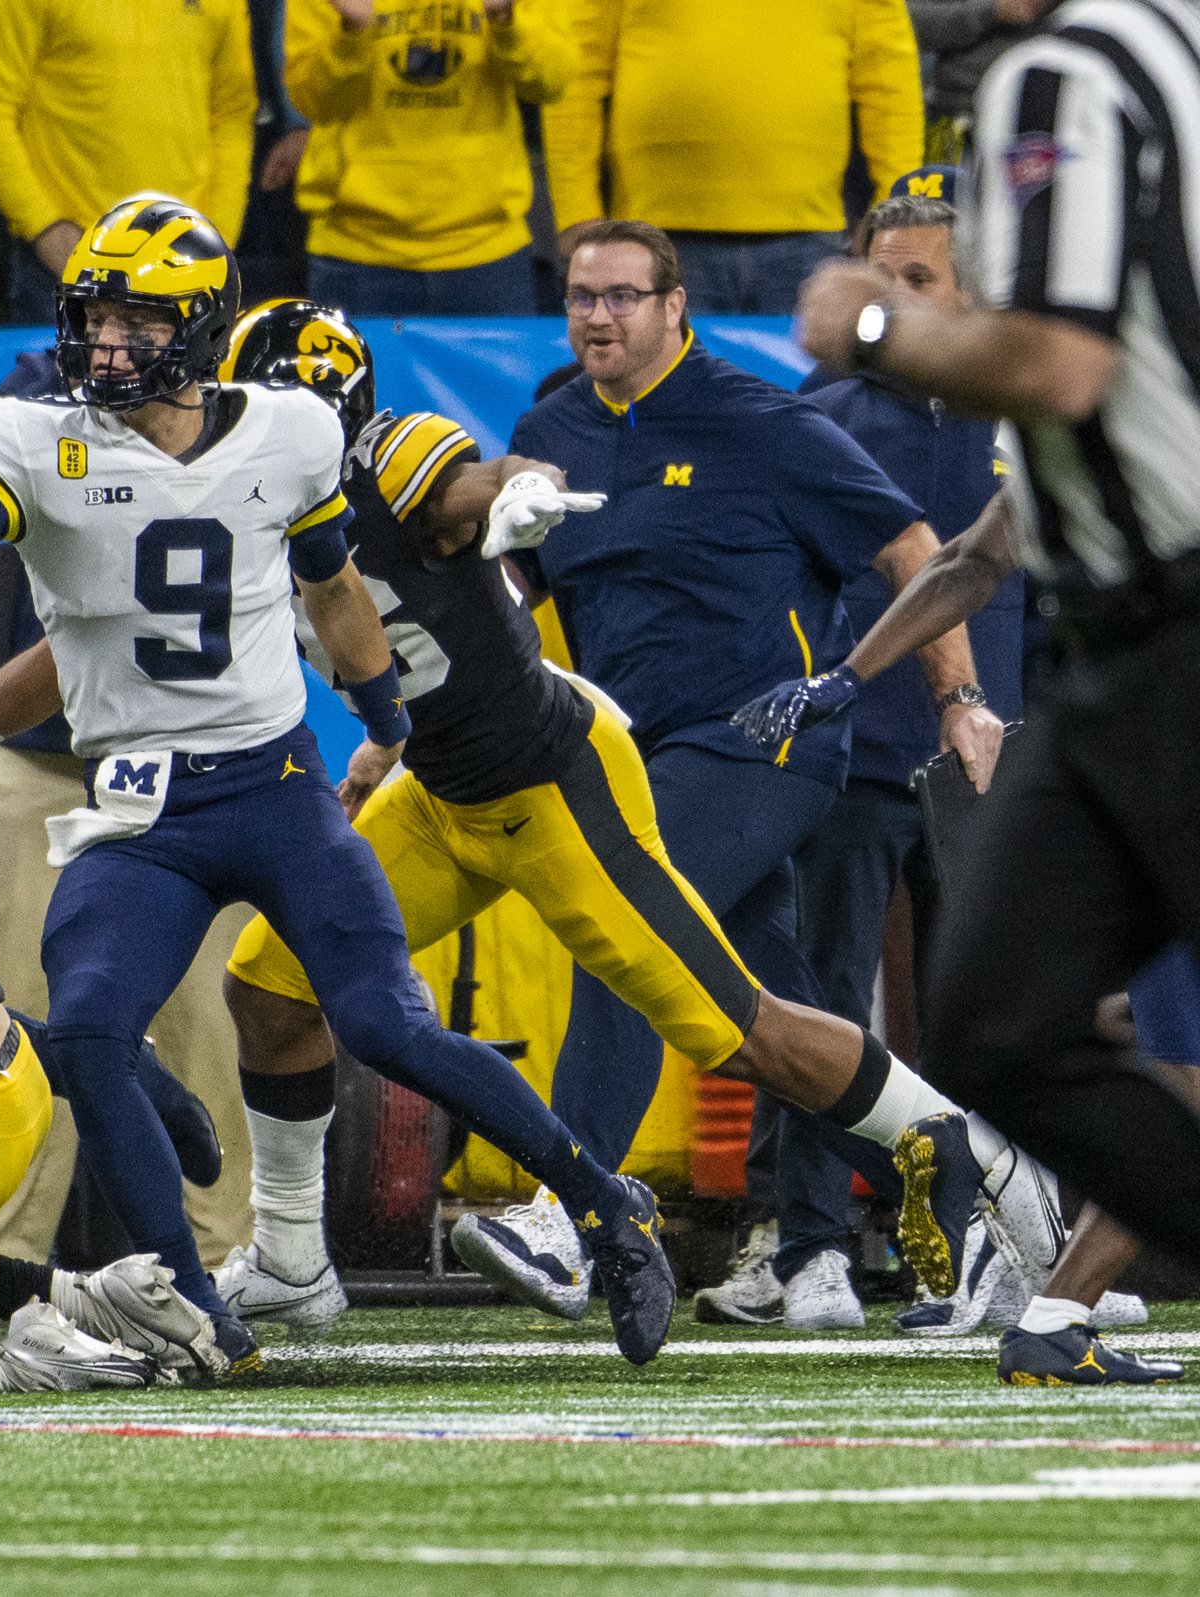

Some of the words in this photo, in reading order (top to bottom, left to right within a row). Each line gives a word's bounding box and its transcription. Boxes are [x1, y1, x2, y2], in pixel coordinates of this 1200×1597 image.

[907, 173, 944, 199] M
[92, 269, 109, 281] M
[66, 453, 80, 463] 42
[664, 464, 692, 486] M
[85, 486, 134, 506] BIG
[134, 518, 234, 681] 9
[108, 760, 160, 795] M
